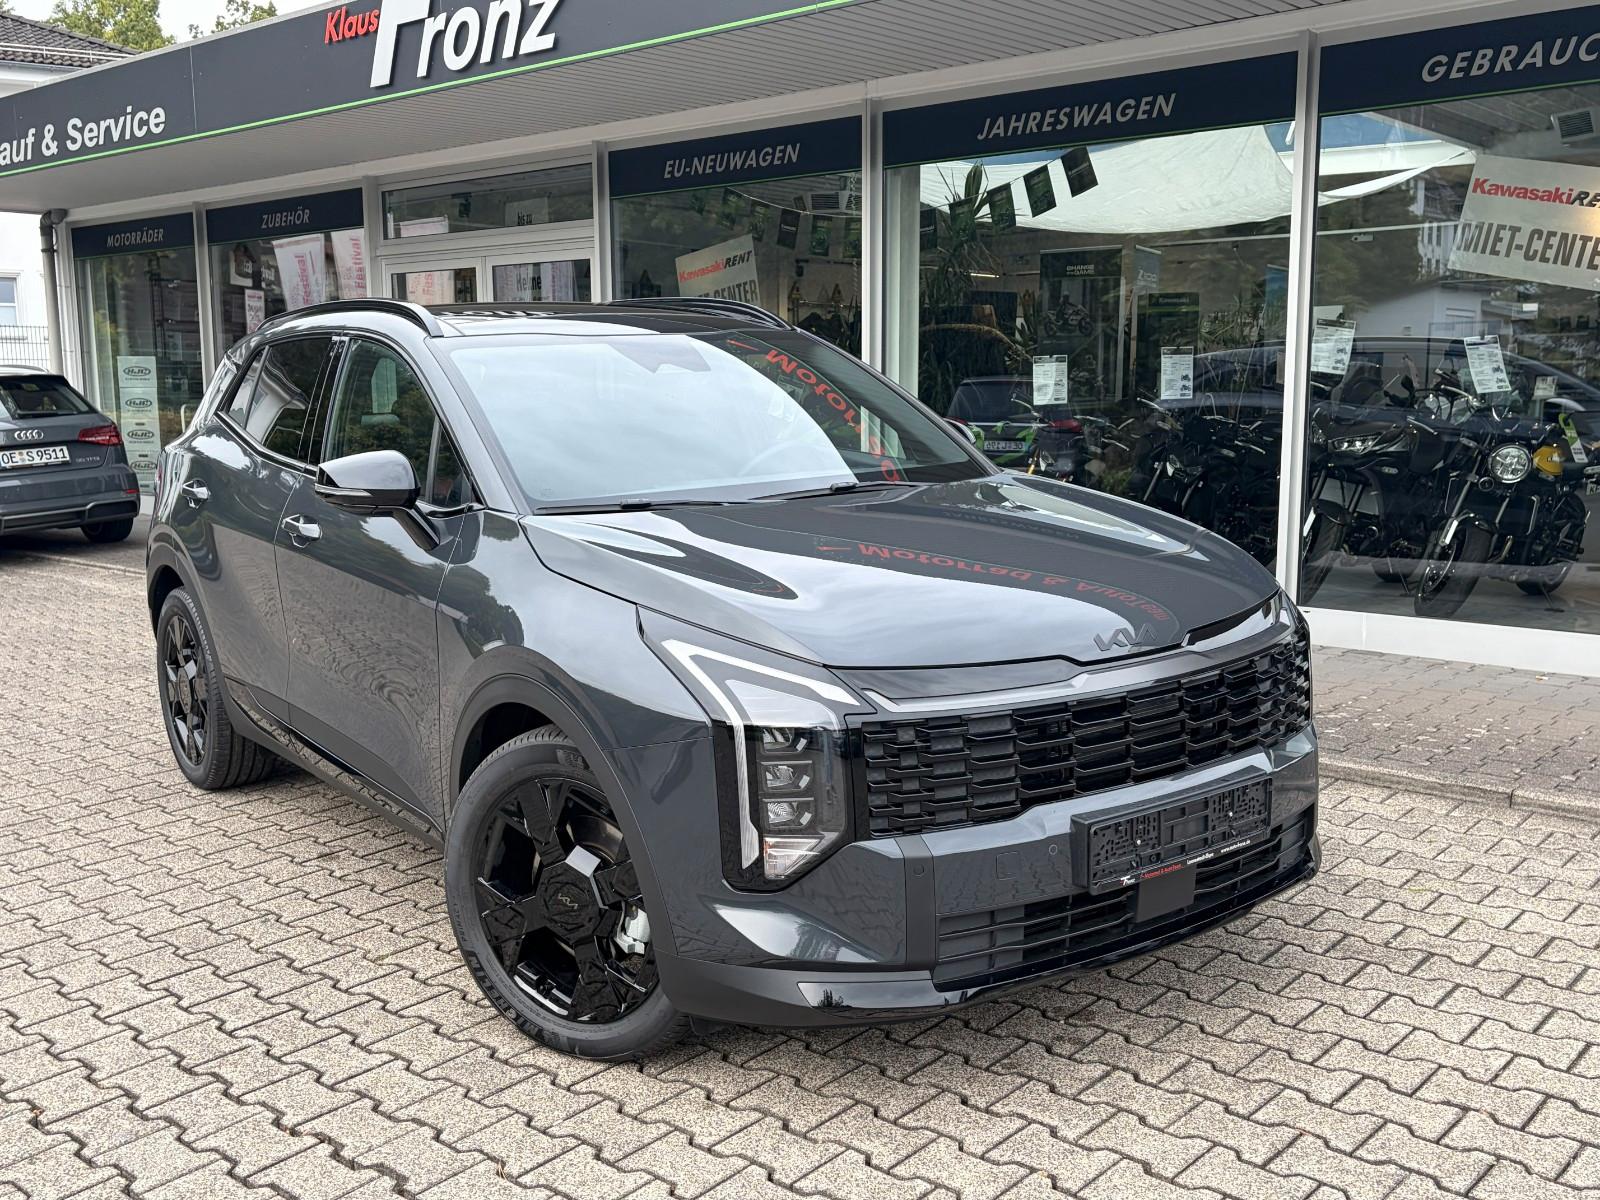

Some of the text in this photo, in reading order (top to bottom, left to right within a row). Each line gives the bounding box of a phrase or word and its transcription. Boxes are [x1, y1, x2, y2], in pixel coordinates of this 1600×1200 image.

[323, 0, 559, 88] Klaus Fronz
[1421, 32, 1600, 83] GEBRAUC
[0, 105, 166, 166] auf & Service
[976, 92, 1177, 140] JAHRESWAGEN
[663, 143, 801, 179] EU-NEUWAGEN
[106, 226, 164, 248] MOTORRÄDER
[261, 206, 311, 229] ZUBEHÖR
[1, 452, 17, 465] OE
[27, 450, 35, 463] S
[37, 447, 68, 462] 9511
